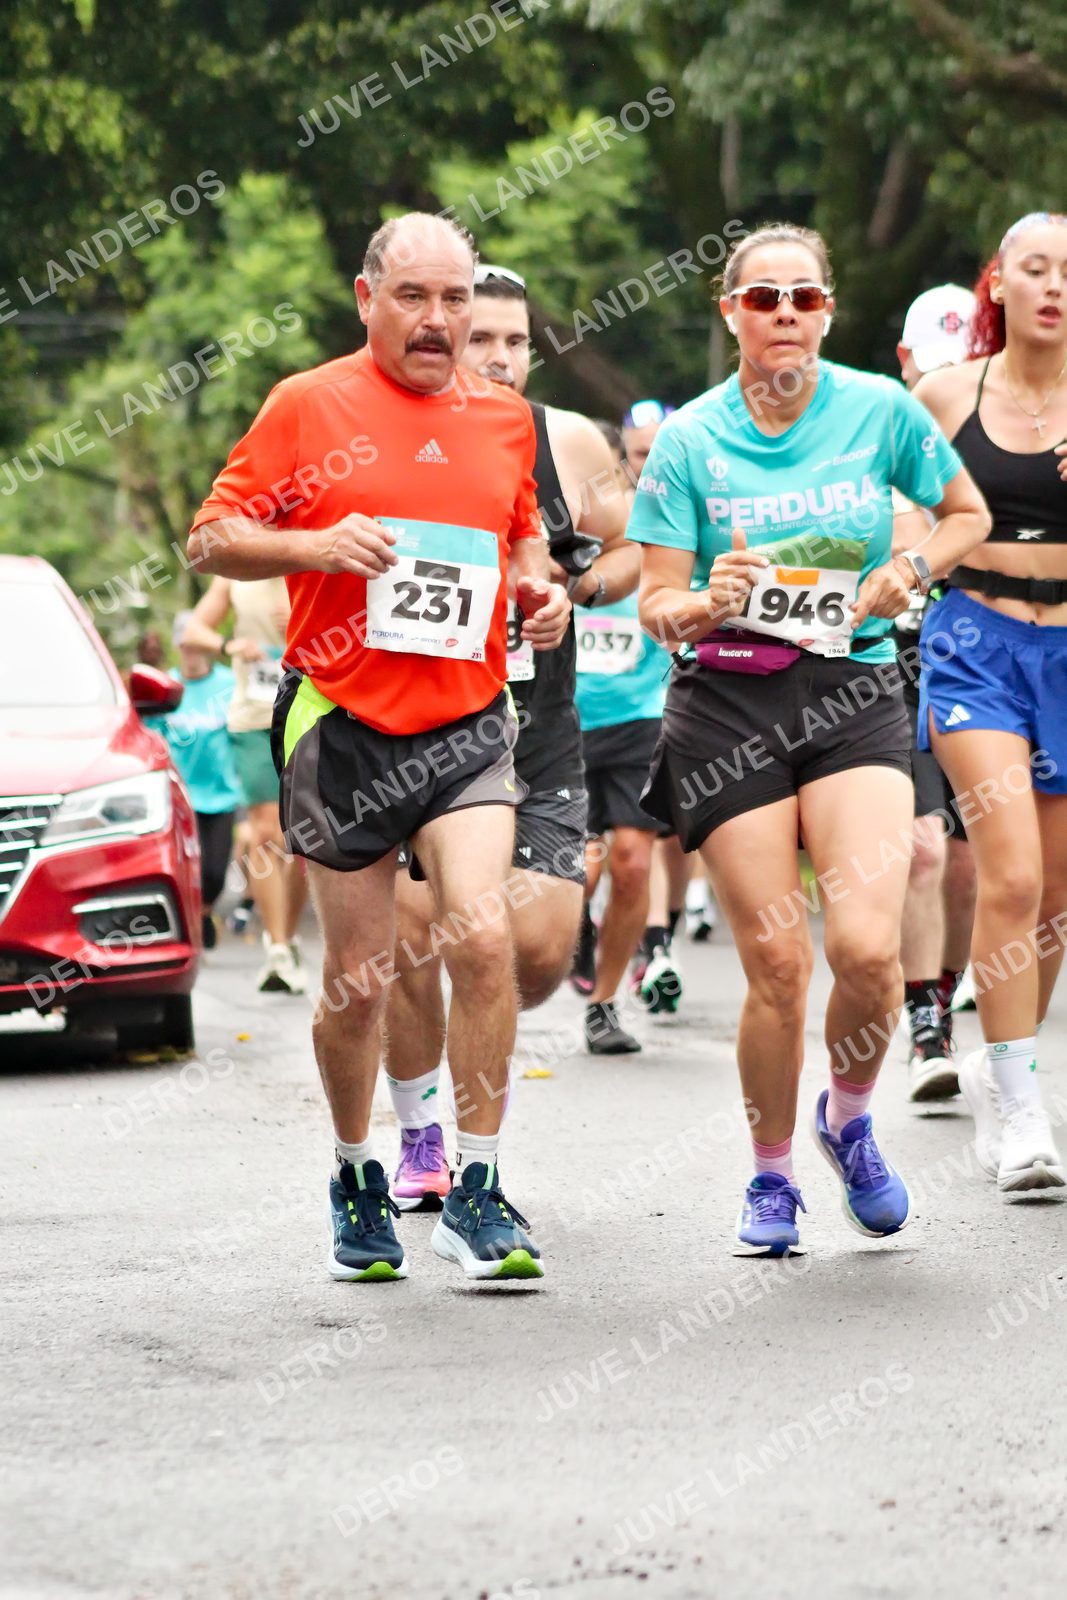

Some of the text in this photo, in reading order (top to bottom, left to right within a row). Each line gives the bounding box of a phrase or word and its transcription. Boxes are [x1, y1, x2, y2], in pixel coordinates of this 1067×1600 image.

[414, 454, 449, 464] adidas
[832, 443, 878, 466] BROOKS
[705, 473, 880, 528] PERDURA
[391, 580, 473, 627] 231
